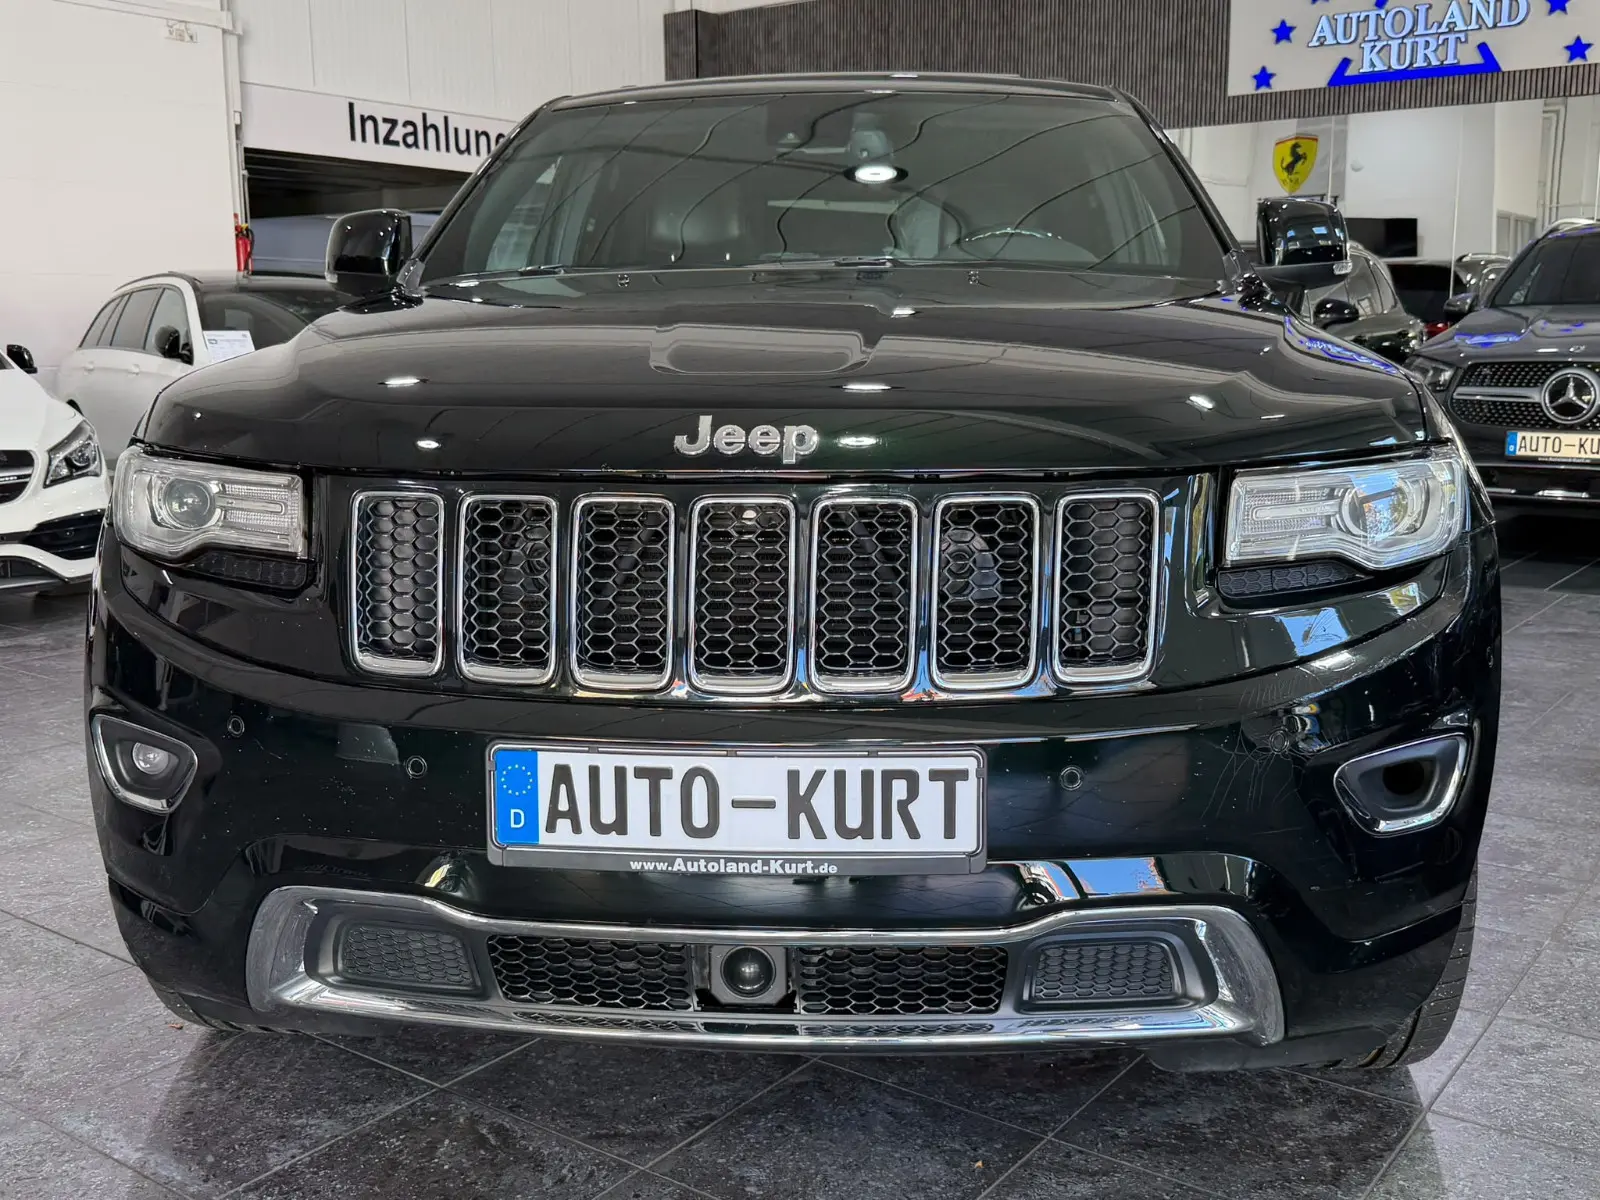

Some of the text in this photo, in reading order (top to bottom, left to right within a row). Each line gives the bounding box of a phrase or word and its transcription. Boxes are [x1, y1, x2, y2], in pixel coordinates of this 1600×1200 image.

[1308, 0, 1530, 47] AUTOLAND
[1359, 32, 1467, 73] KURT
[674, 415, 819, 464] Jeep
[510, 808, 525, 829] D
[629, 857, 838, 875] www.Autoland-Kurt.de
